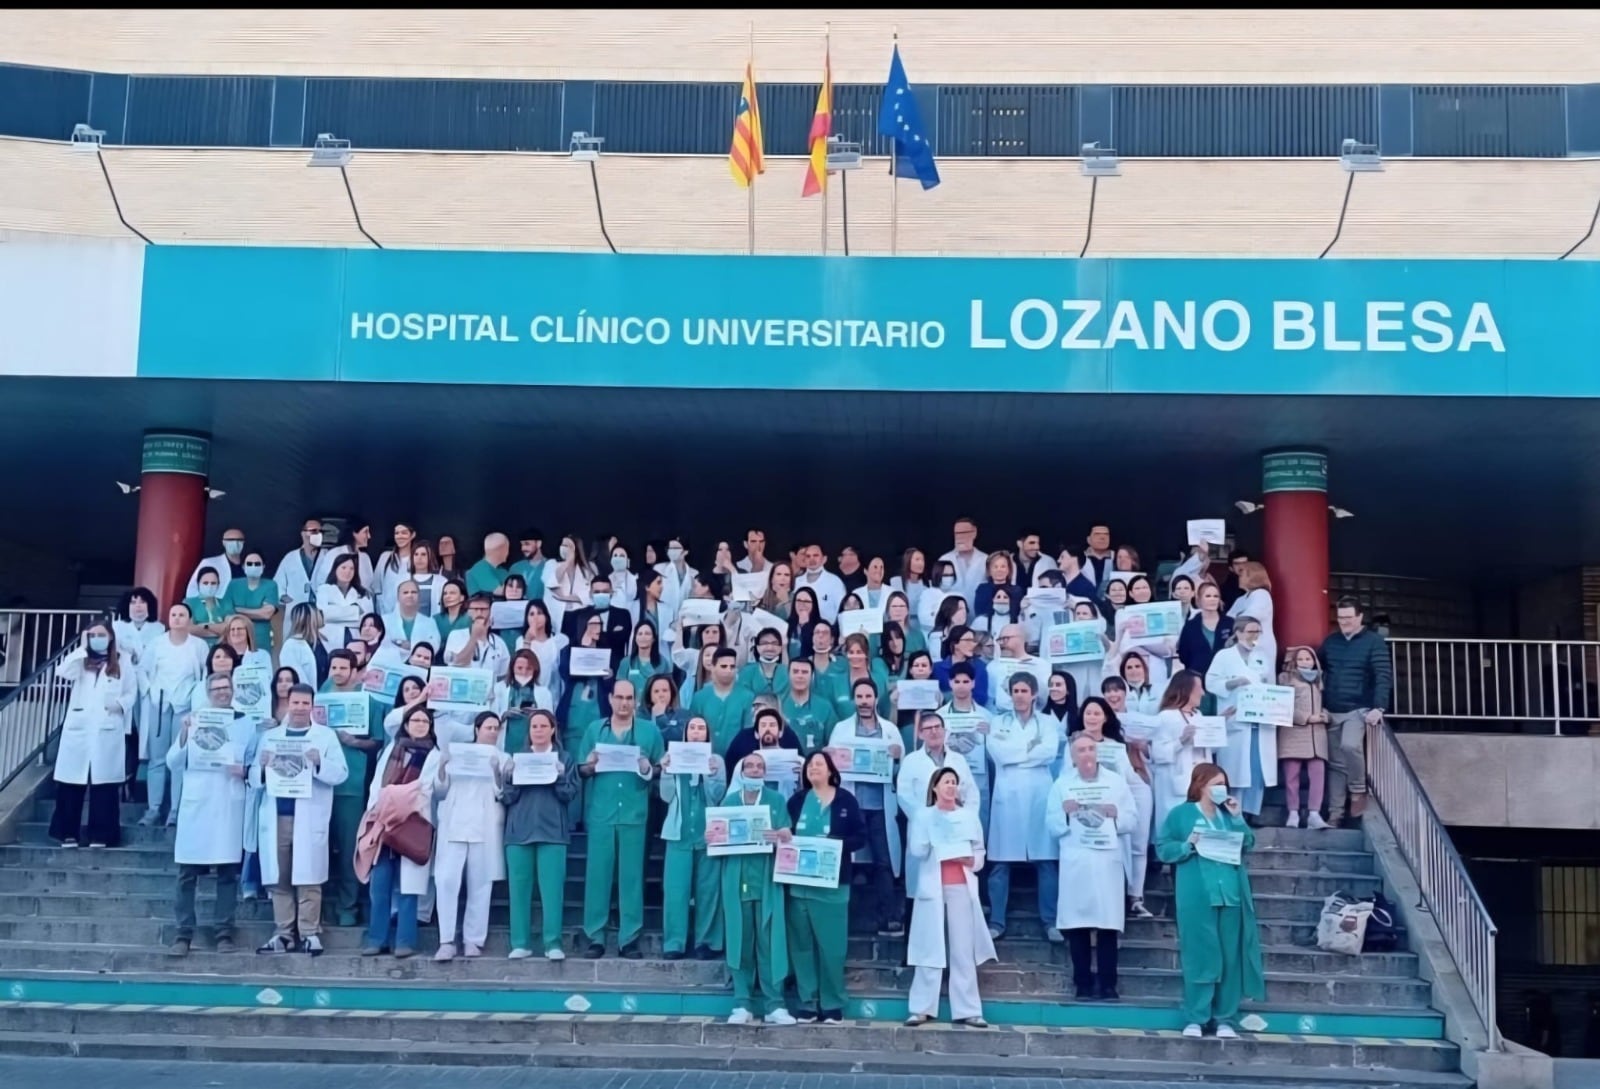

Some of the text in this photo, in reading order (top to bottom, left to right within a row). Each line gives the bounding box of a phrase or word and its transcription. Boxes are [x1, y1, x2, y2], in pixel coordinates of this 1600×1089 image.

[350, 299, 1506, 353] HOSPITAL CLÍNICO UNIVERSITARIO LOZANO BLESA
